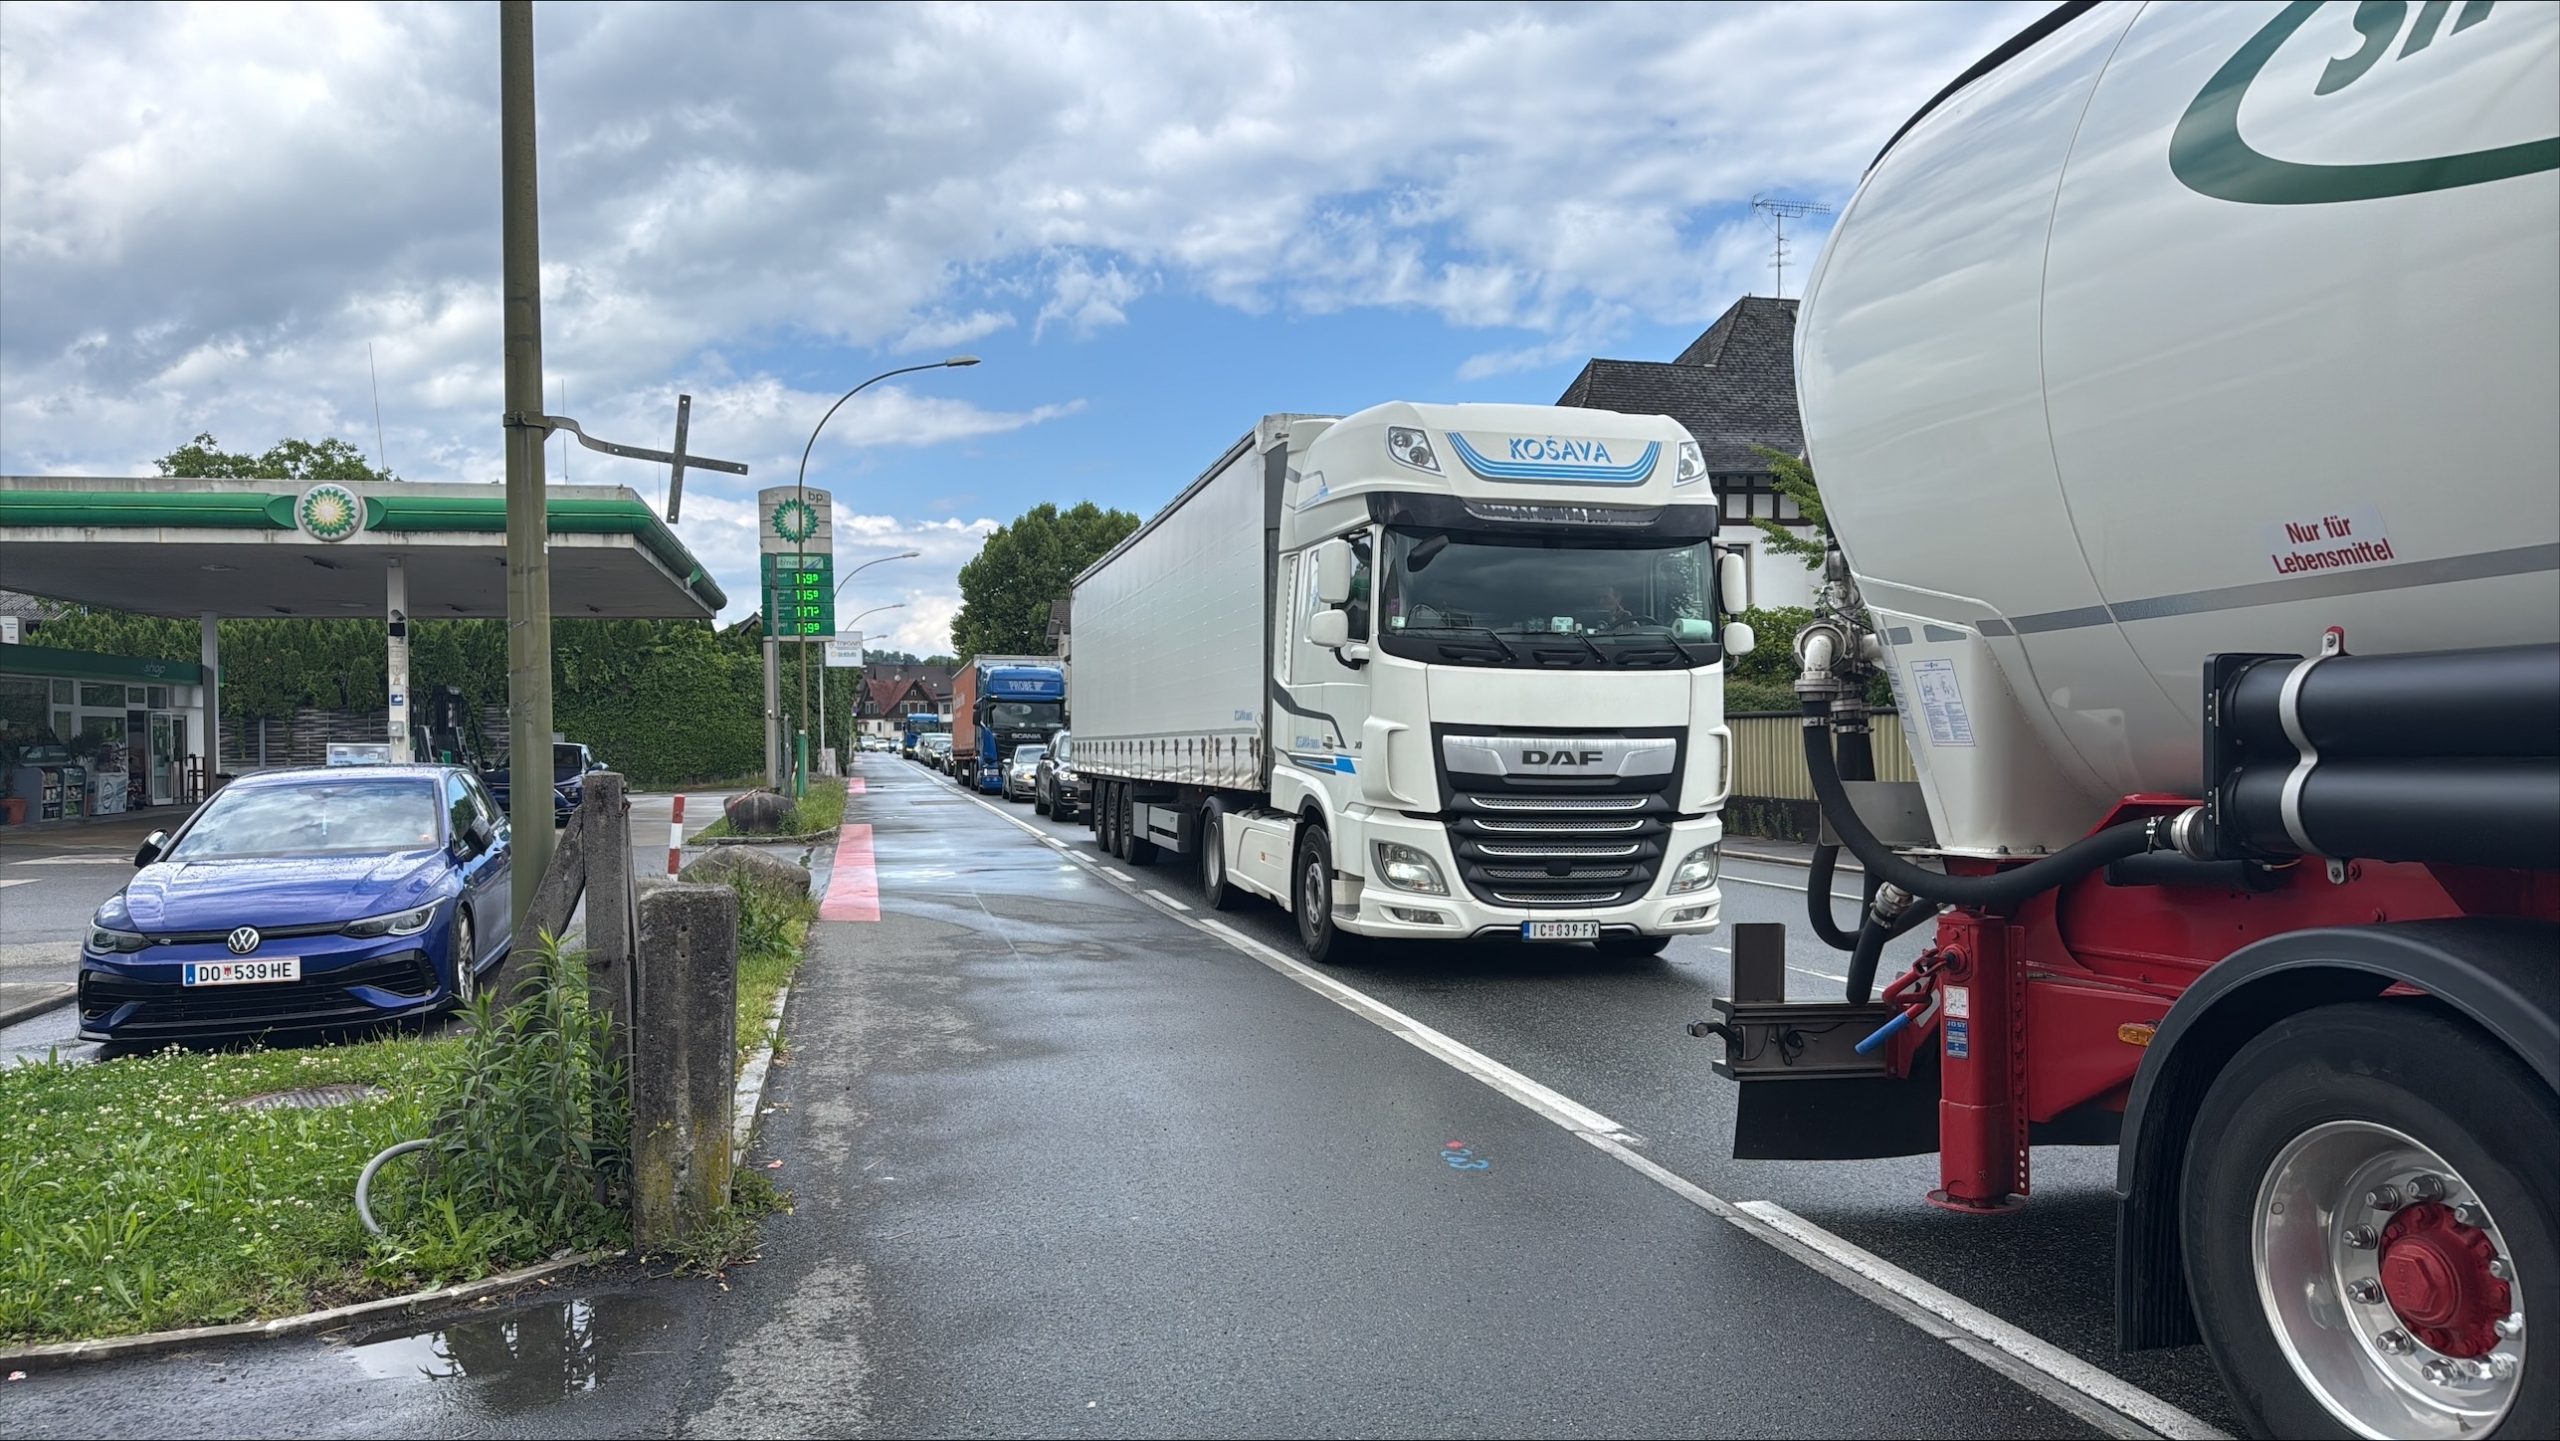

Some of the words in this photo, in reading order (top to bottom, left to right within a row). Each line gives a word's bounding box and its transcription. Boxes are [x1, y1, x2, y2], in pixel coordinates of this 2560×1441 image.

[1509, 435, 1613, 464] KOŠAVA
[808, 490, 823, 503] bp
[2284, 522, 2321, 544] Nur
[2323, 515, 2352, 538] für
[2271, 537, 2395, 574] Lebensmittel
[143, 660, 166, 677] shop
[1522, 750, 1603, 766] DAF
[199, 966, 220, 982] DO
[234, 963, 267, 980] 539
[271, 962, 292, 978] HE
